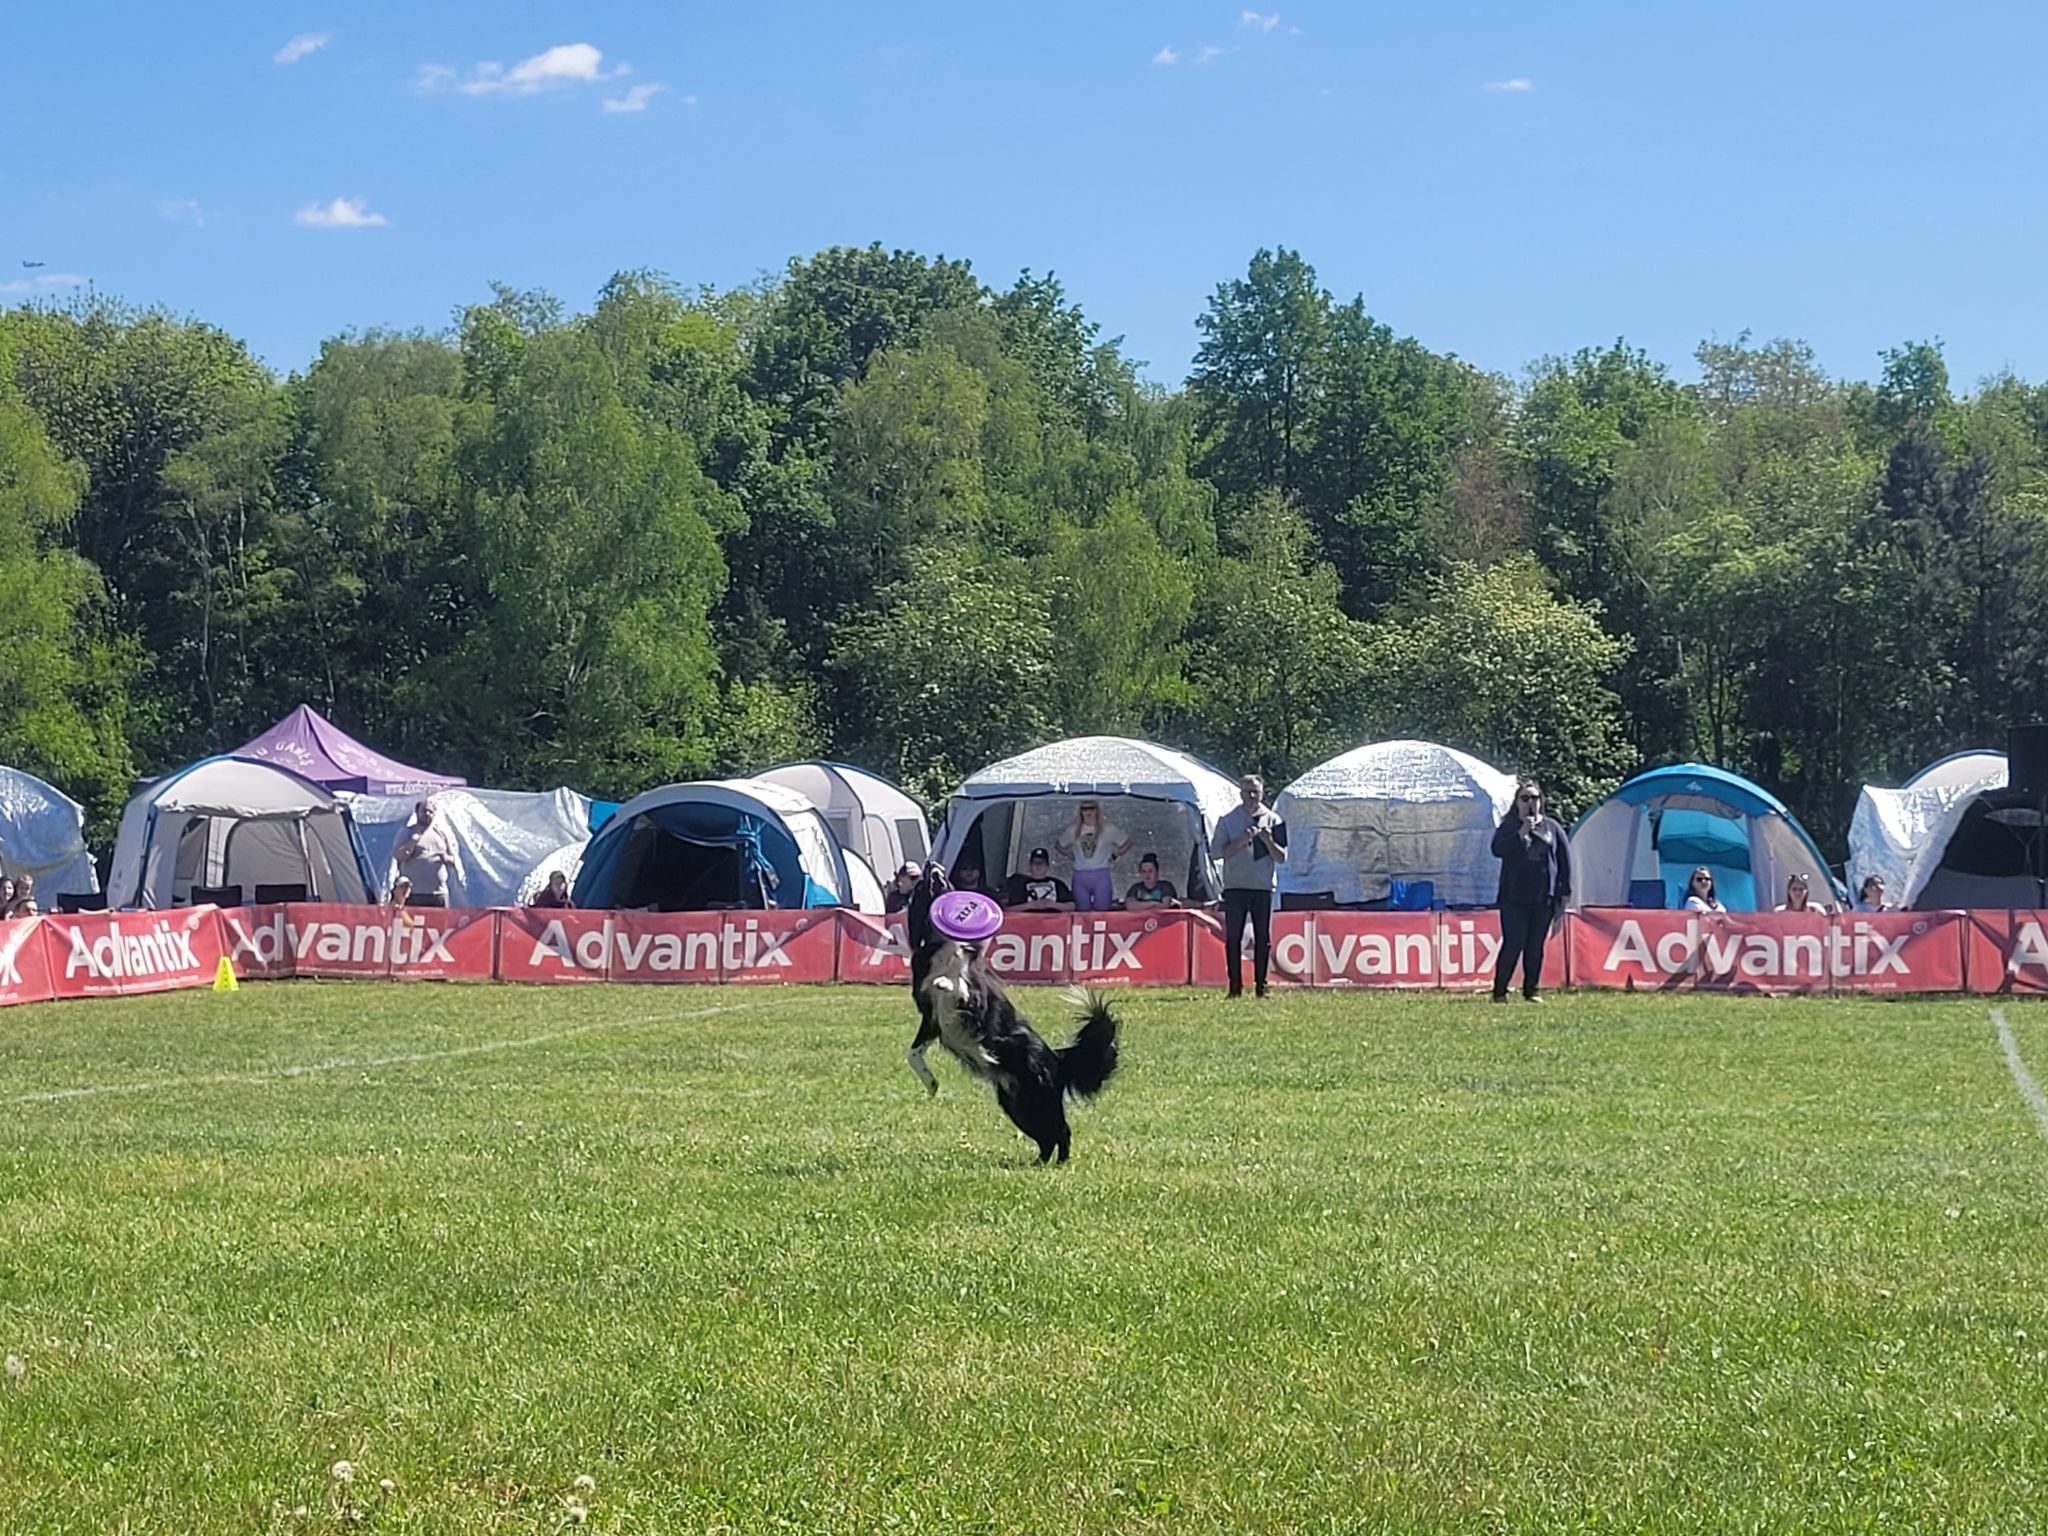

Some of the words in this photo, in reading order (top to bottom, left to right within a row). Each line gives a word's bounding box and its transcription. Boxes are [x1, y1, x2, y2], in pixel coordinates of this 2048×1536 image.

[65, 919, 201, 978] Advantix
[529, 919, 793, 970] Advantix
[1603, 919, 1911, 977] Advantix
